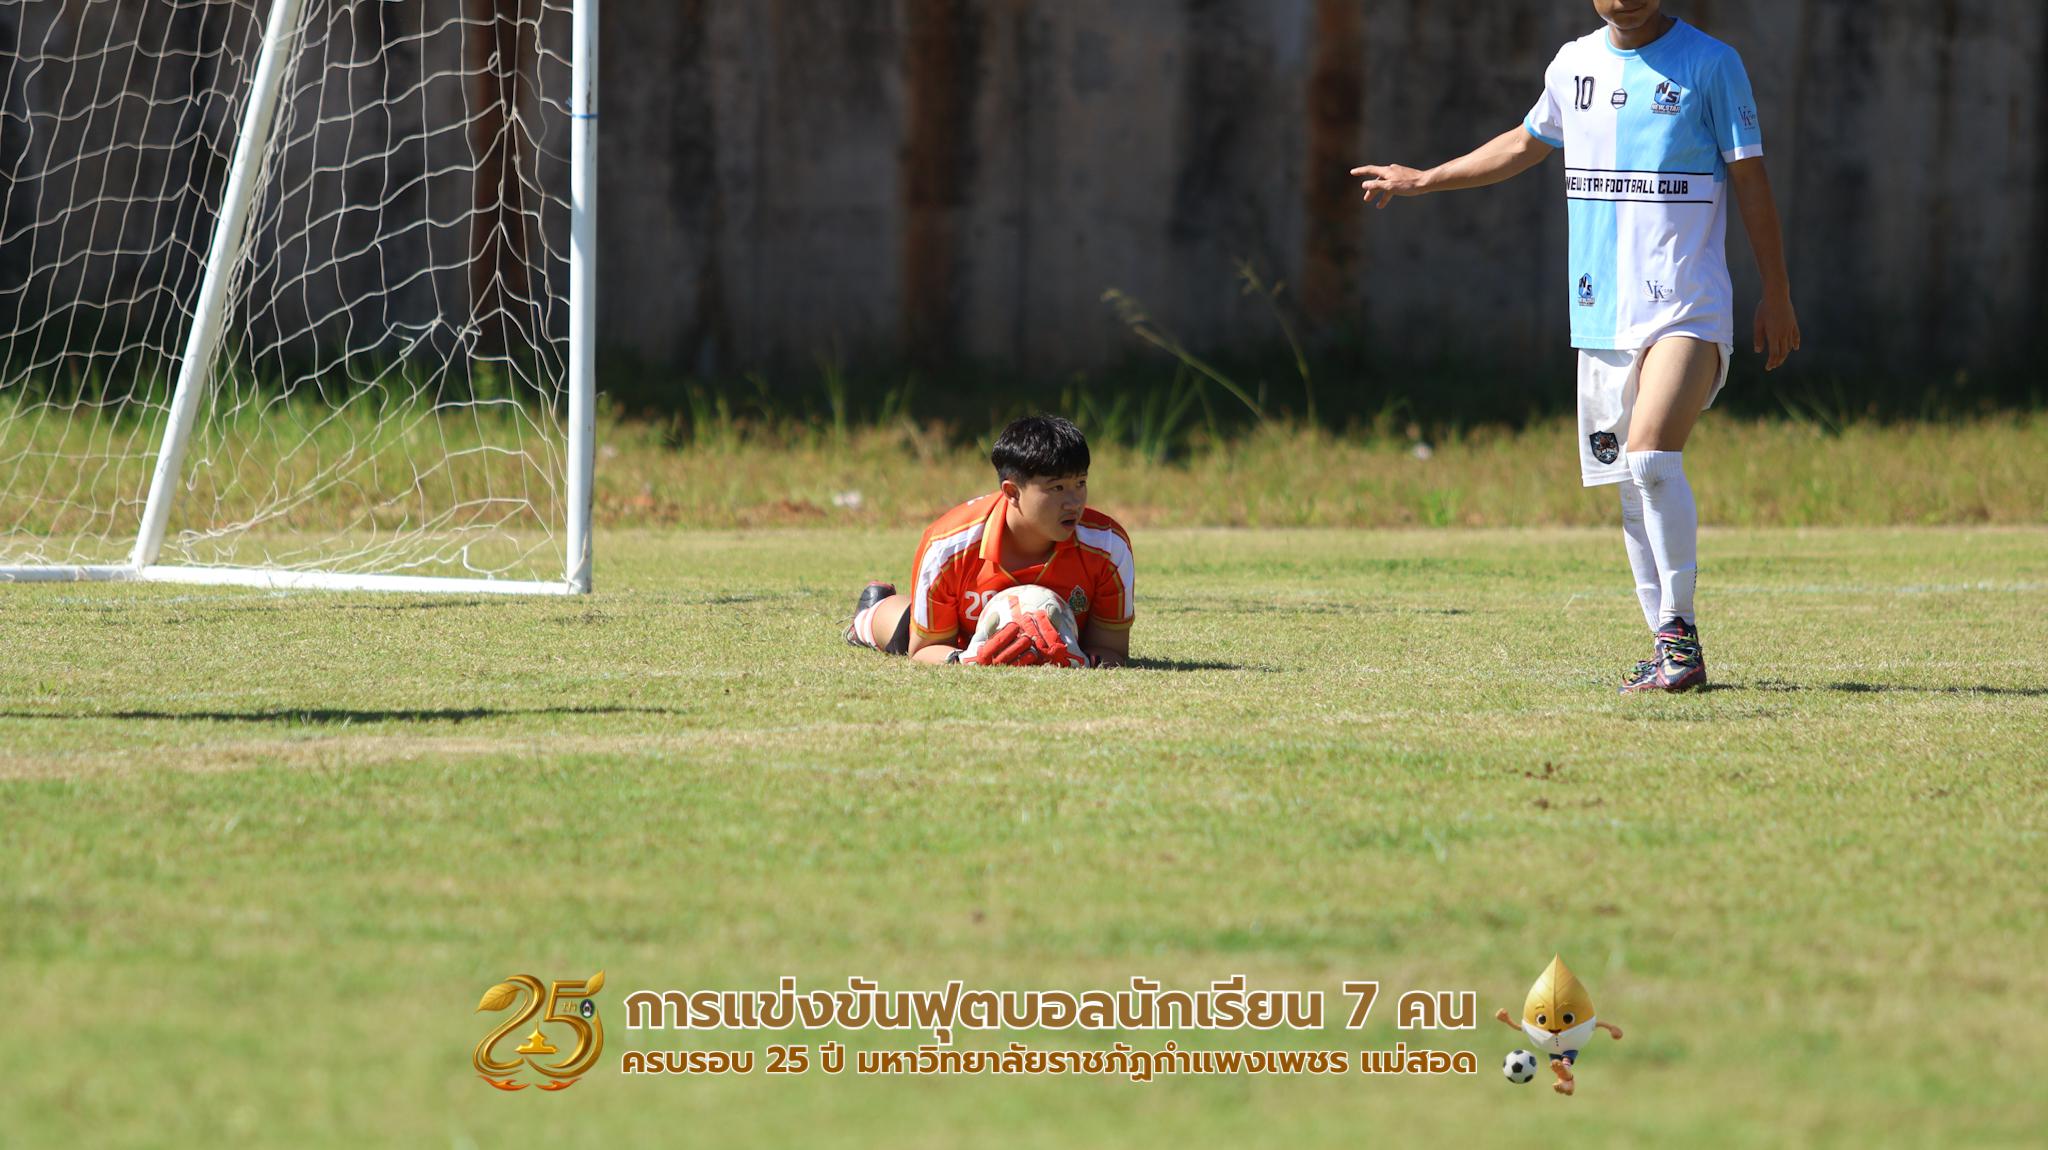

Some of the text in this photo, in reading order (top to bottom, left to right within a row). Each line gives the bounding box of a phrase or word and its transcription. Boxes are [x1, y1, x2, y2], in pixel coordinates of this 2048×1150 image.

[1574, 75, 1594, 111] 10
[1605, 178, 1655, 194] FOOTBALL
[1658, 180, 1688, 194] CLUB
